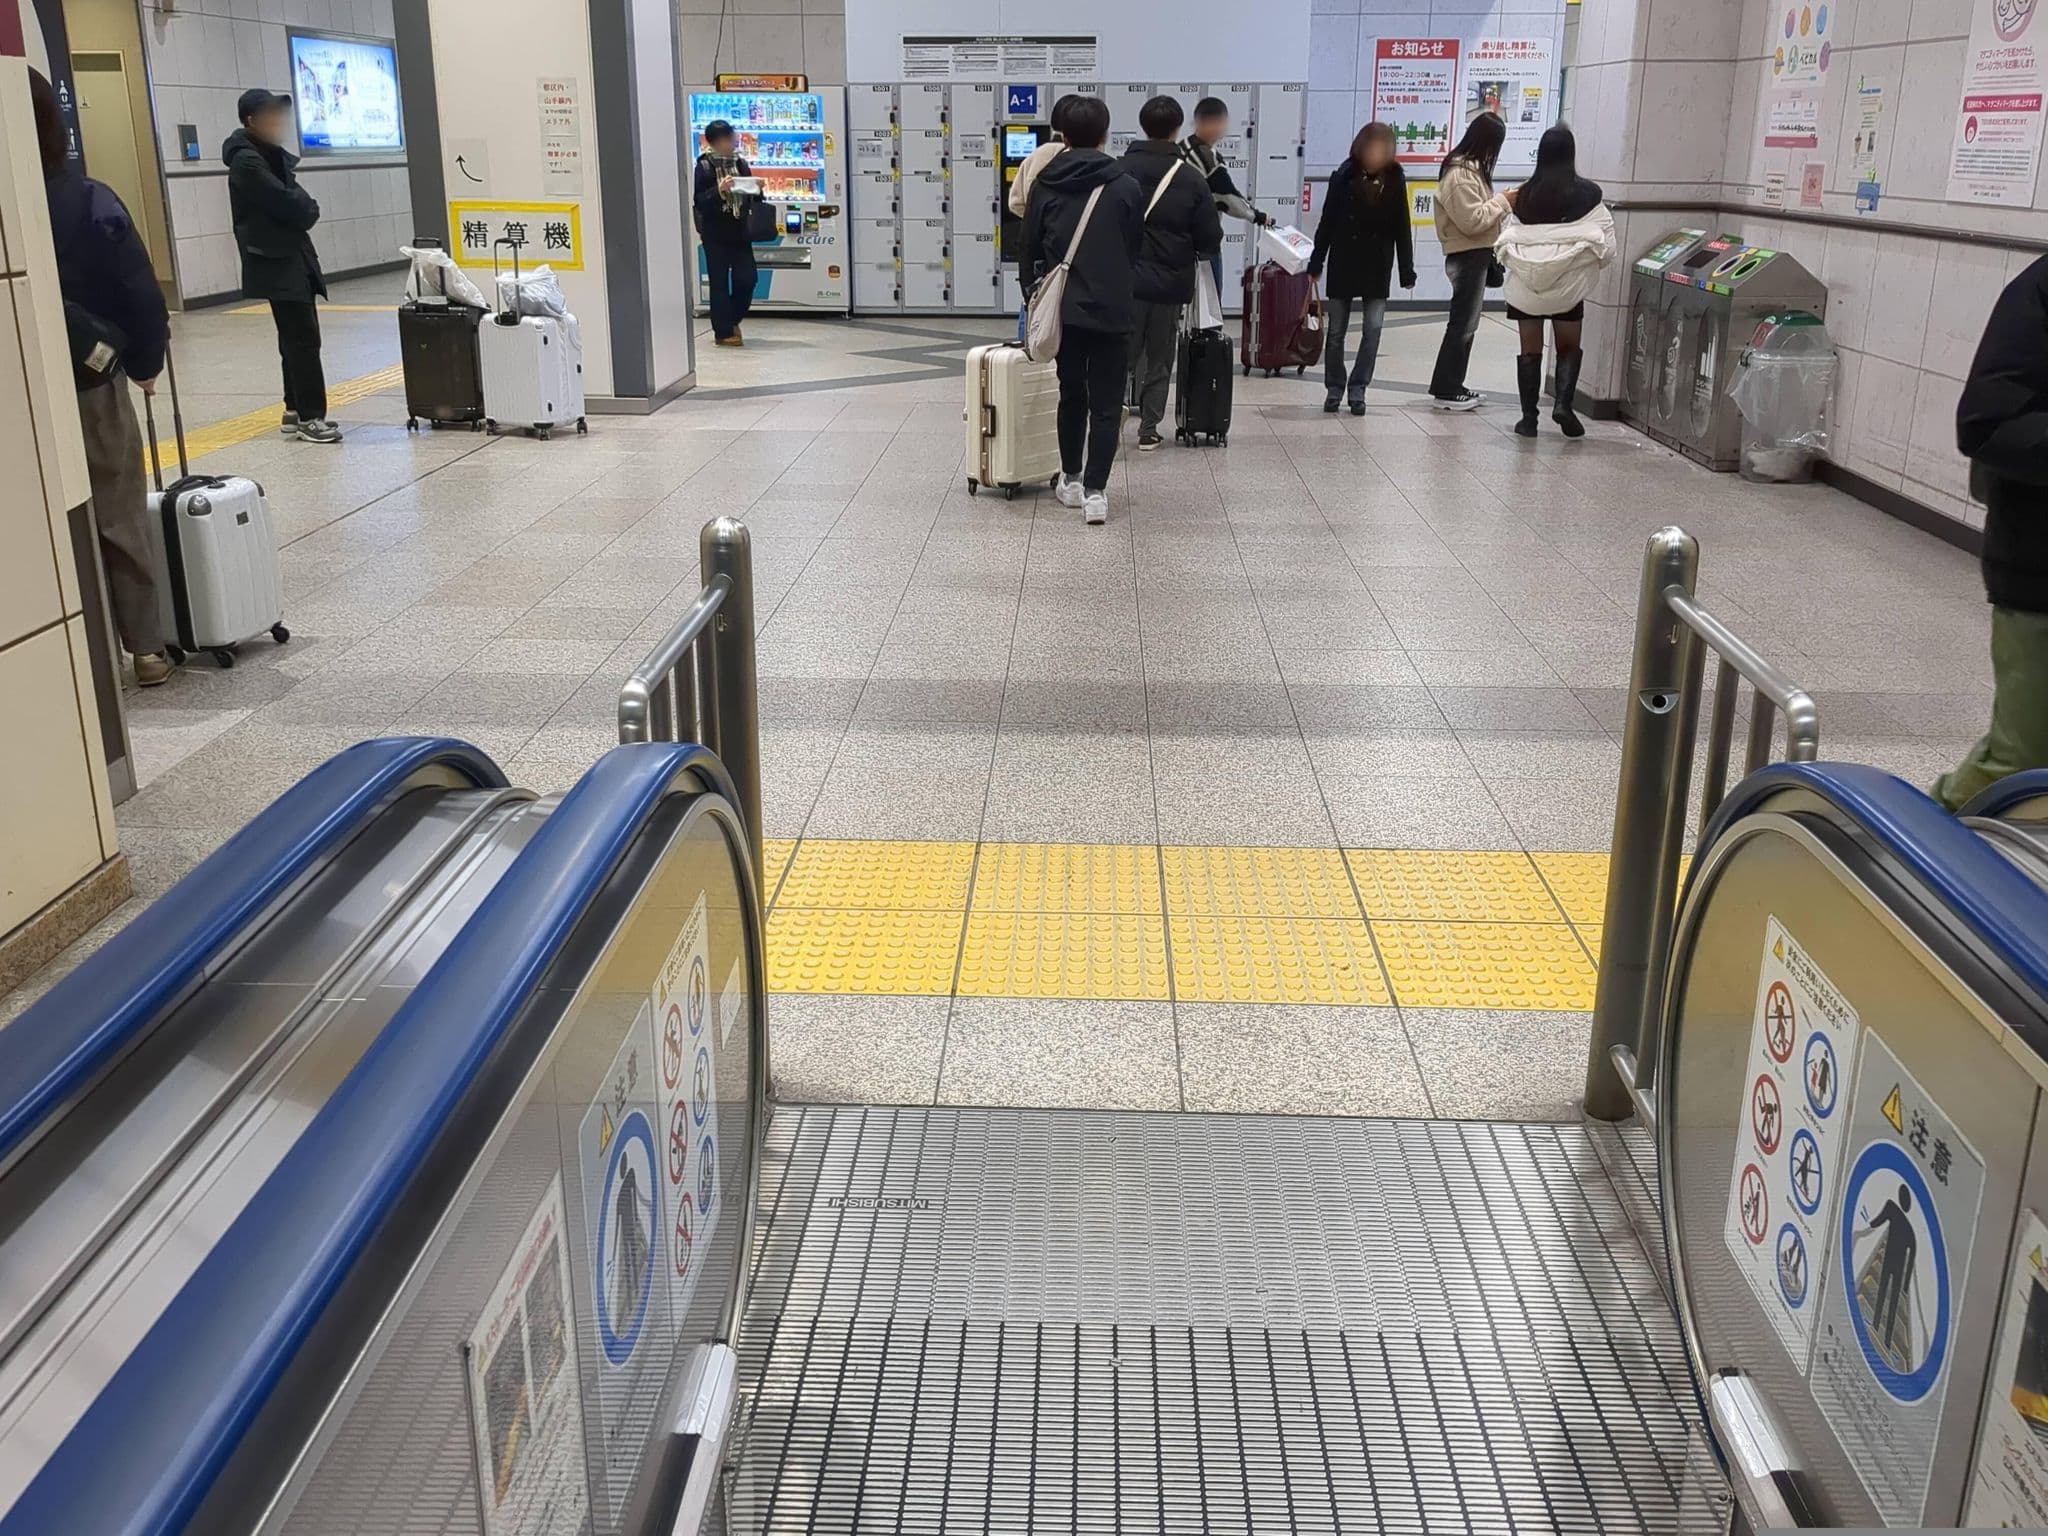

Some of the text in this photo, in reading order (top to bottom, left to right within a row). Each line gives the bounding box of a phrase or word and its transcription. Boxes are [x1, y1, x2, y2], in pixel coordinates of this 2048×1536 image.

[1391, 41, 1444, 56] お知らせ
[1481, 41, 1537, 50] 乗り越し精算は
[1468, 51, 1549, 60] 自動精算機をご利用ください
[1010, 94, 1033, 106] A-1
[1414, 194, 1431, 213] 精
[462, 221, 572, 250] 精算機
[797, 235, 835, 245] acure
[615, 1047, 638, 1118] 注意
[1908, 1108, 1953, 1187] 注意
[829, 1197, 928, 1209] MITSUBISHI
